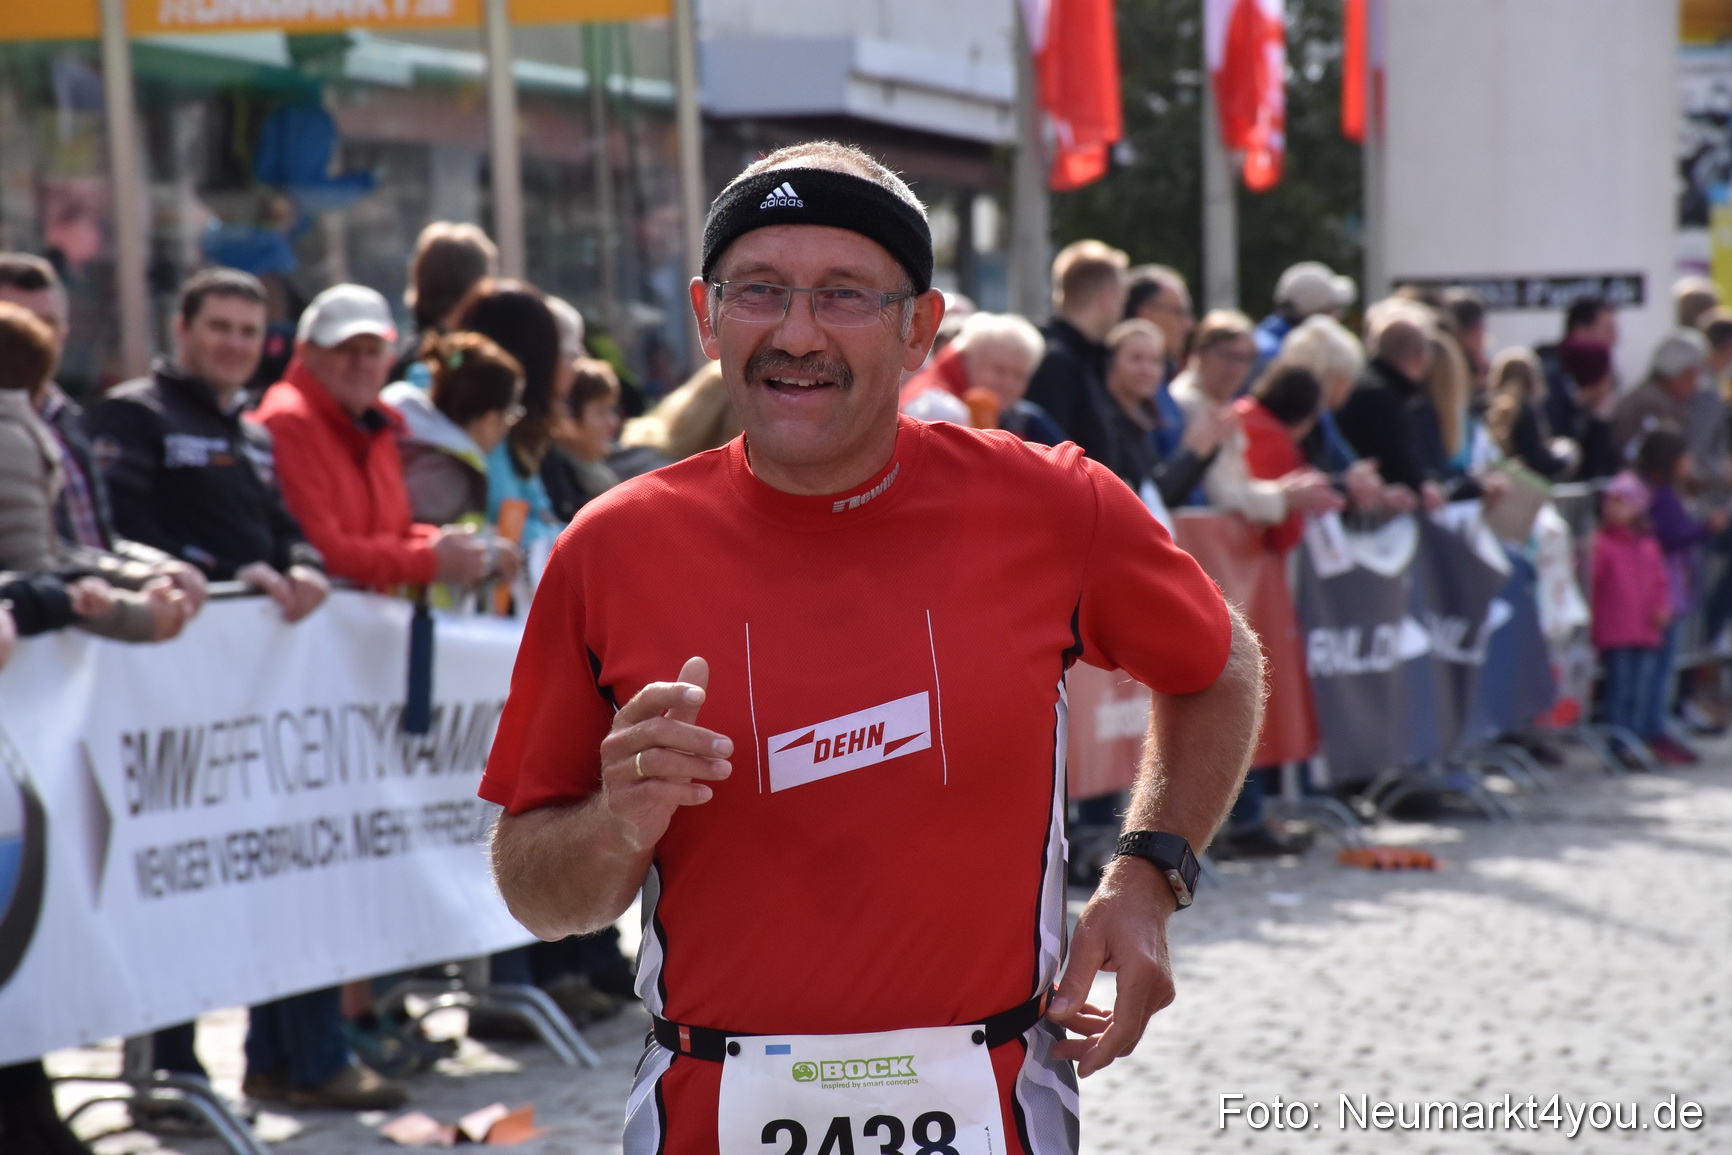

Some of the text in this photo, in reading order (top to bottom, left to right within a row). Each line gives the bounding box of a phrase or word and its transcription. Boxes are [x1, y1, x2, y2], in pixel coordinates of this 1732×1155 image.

[760, 197, 804, 209] adidas
[813, 721, 885, 764] DEHN
[820, 1055, 917, 1081] BOCK
[821, 1082, 850, 1090] inspired
[886, 1078, 919, 1086] concepts
